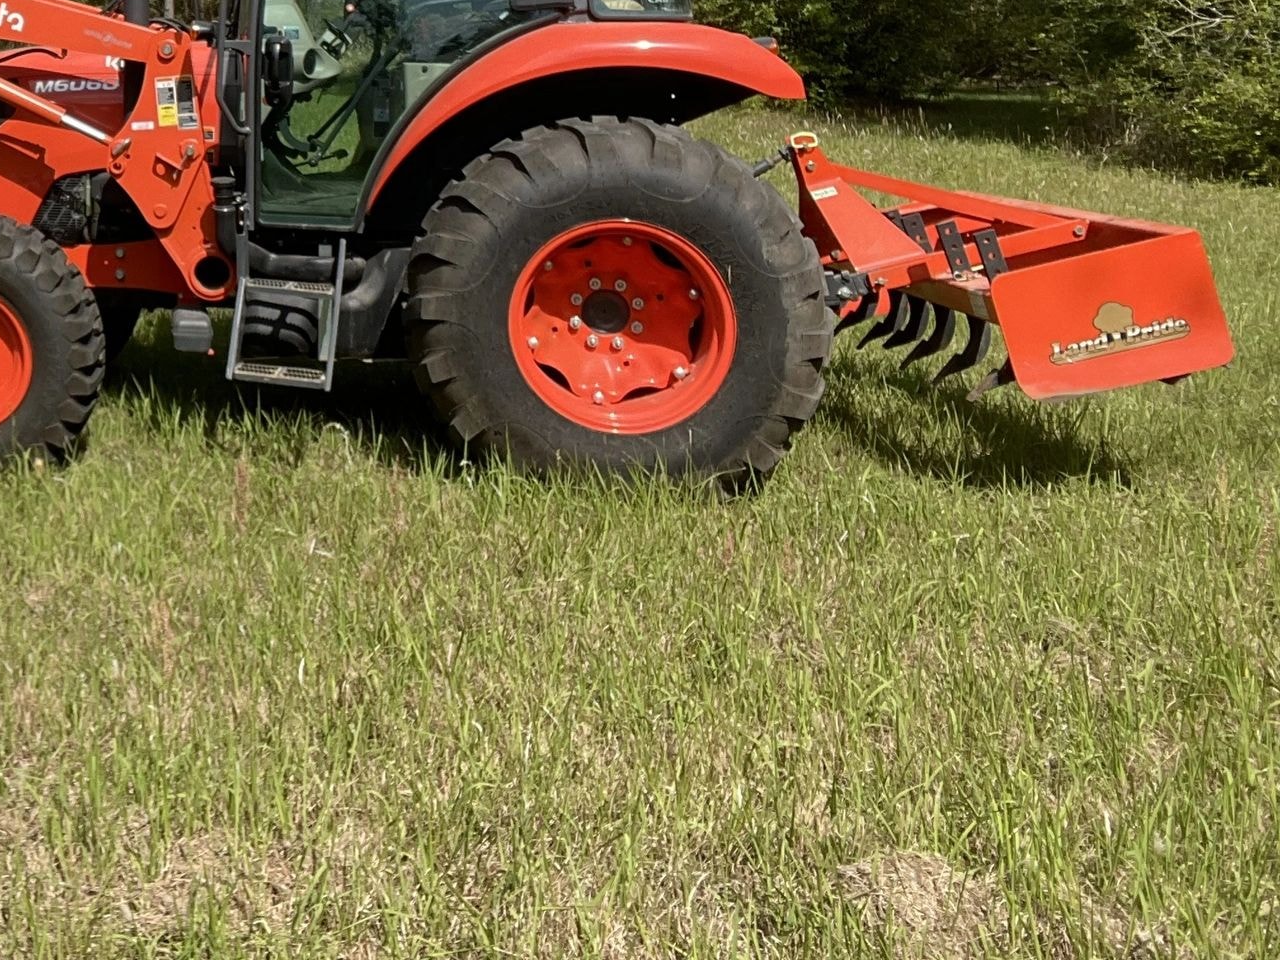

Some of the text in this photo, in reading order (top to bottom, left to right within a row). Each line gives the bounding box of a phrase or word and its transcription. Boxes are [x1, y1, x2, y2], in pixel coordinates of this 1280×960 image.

[35, 78, 120, 94] M6060
[1051, 317, 1188, 361] Land Pride
